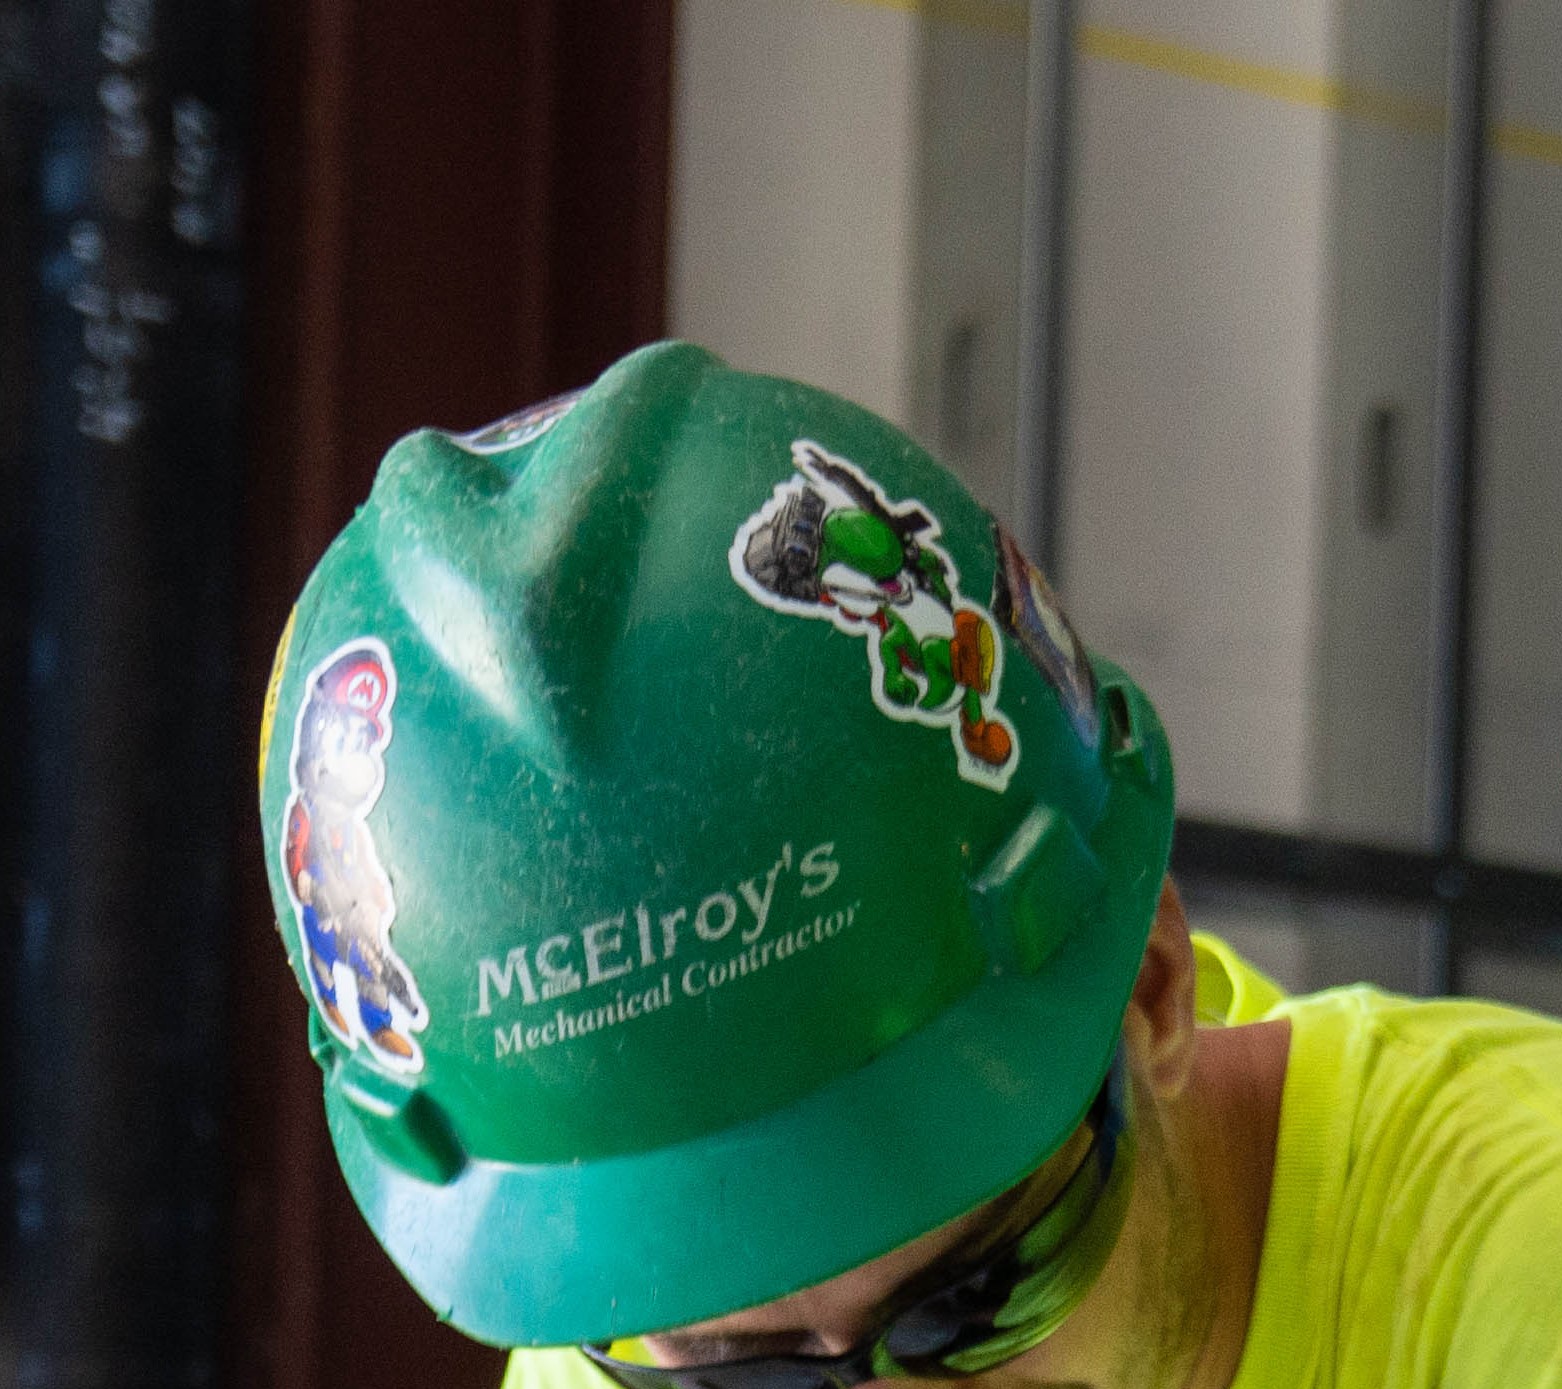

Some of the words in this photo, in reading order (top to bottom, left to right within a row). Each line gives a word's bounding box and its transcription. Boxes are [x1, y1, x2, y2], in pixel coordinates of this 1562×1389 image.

[475, 841, 840, 1017] McElroy's
[493, 974, 673, 1060] Mechanical
[681, 900, 863, 997] Contractor
